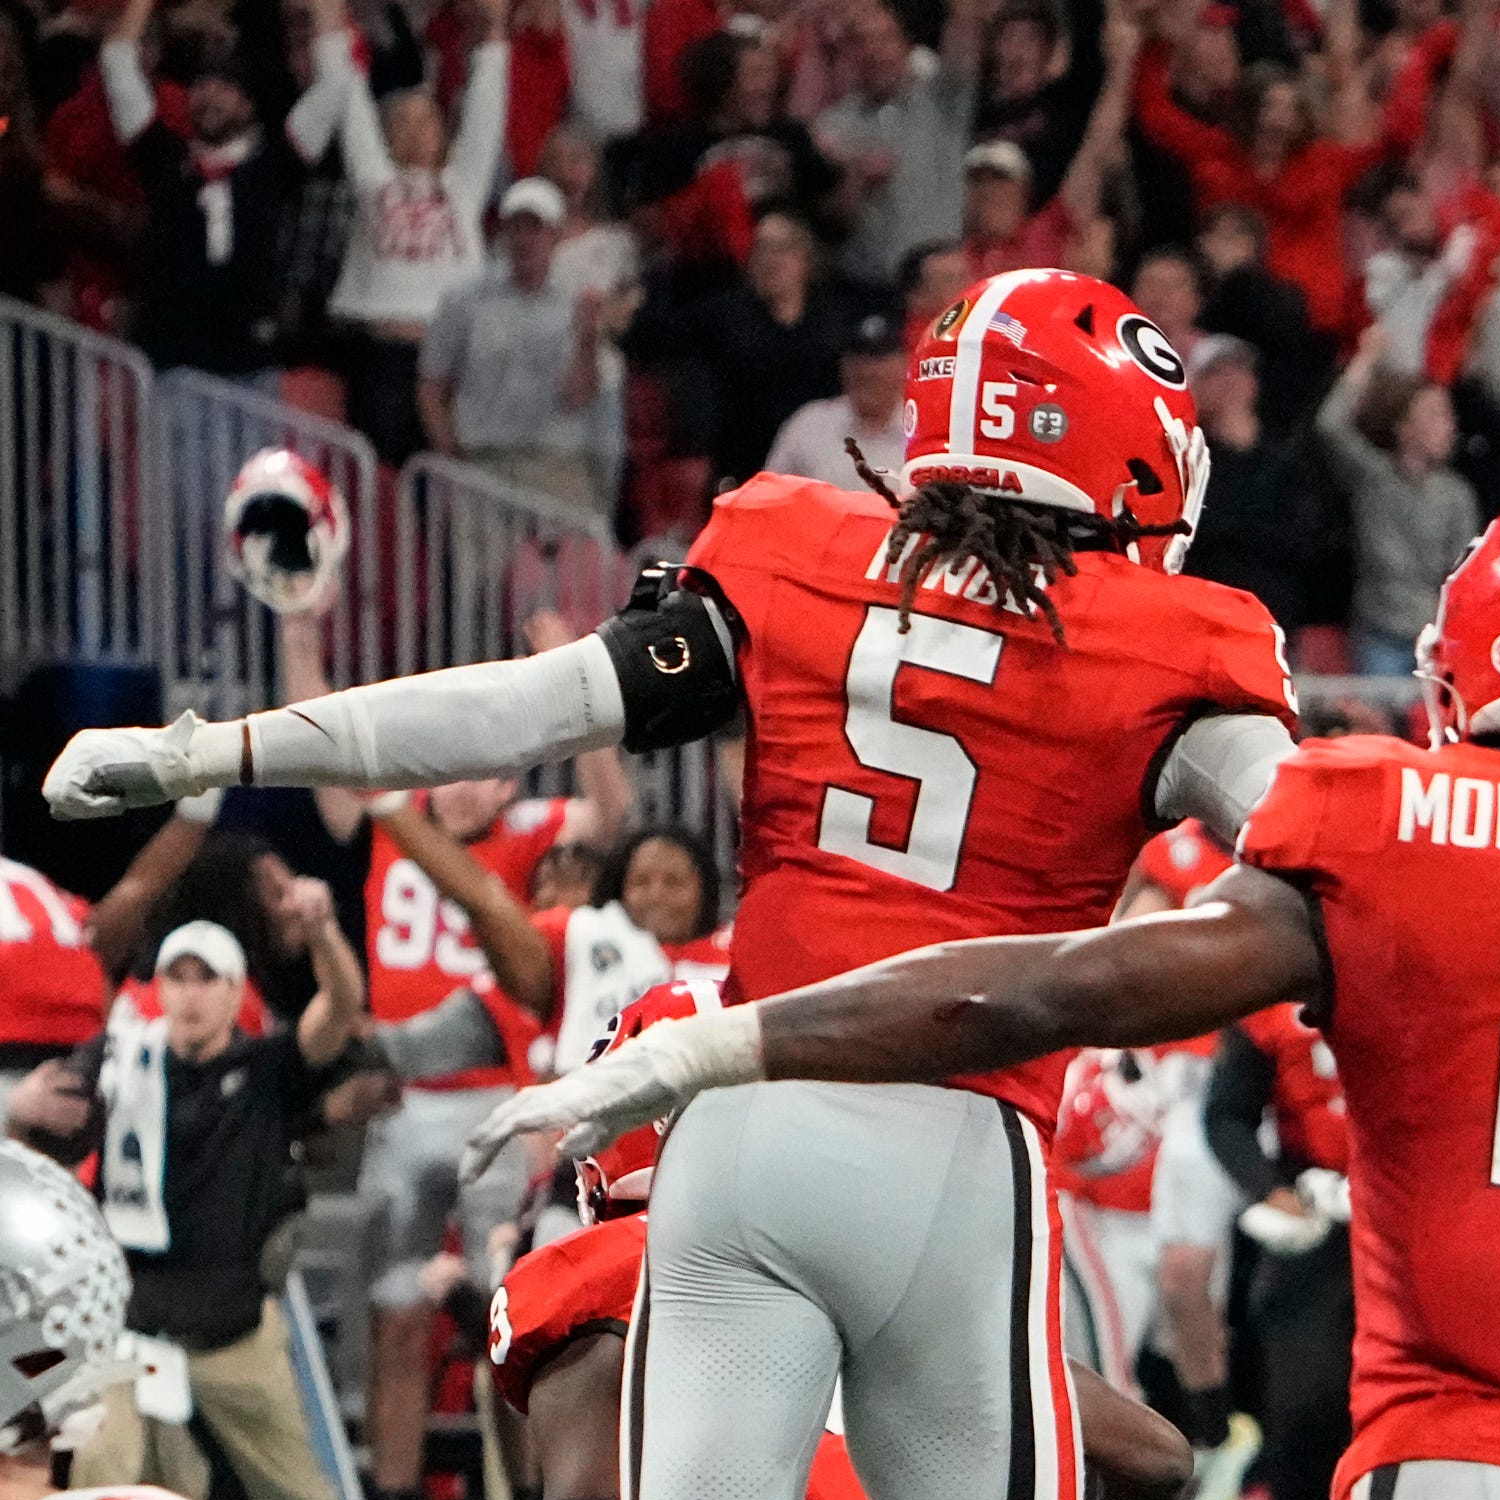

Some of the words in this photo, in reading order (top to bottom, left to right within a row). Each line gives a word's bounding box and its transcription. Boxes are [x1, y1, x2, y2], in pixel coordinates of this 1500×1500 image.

[198, 182, 233, 266] 1
[979, 381, 1018, 440] 5
[817, 604, 1004, 894] 5
